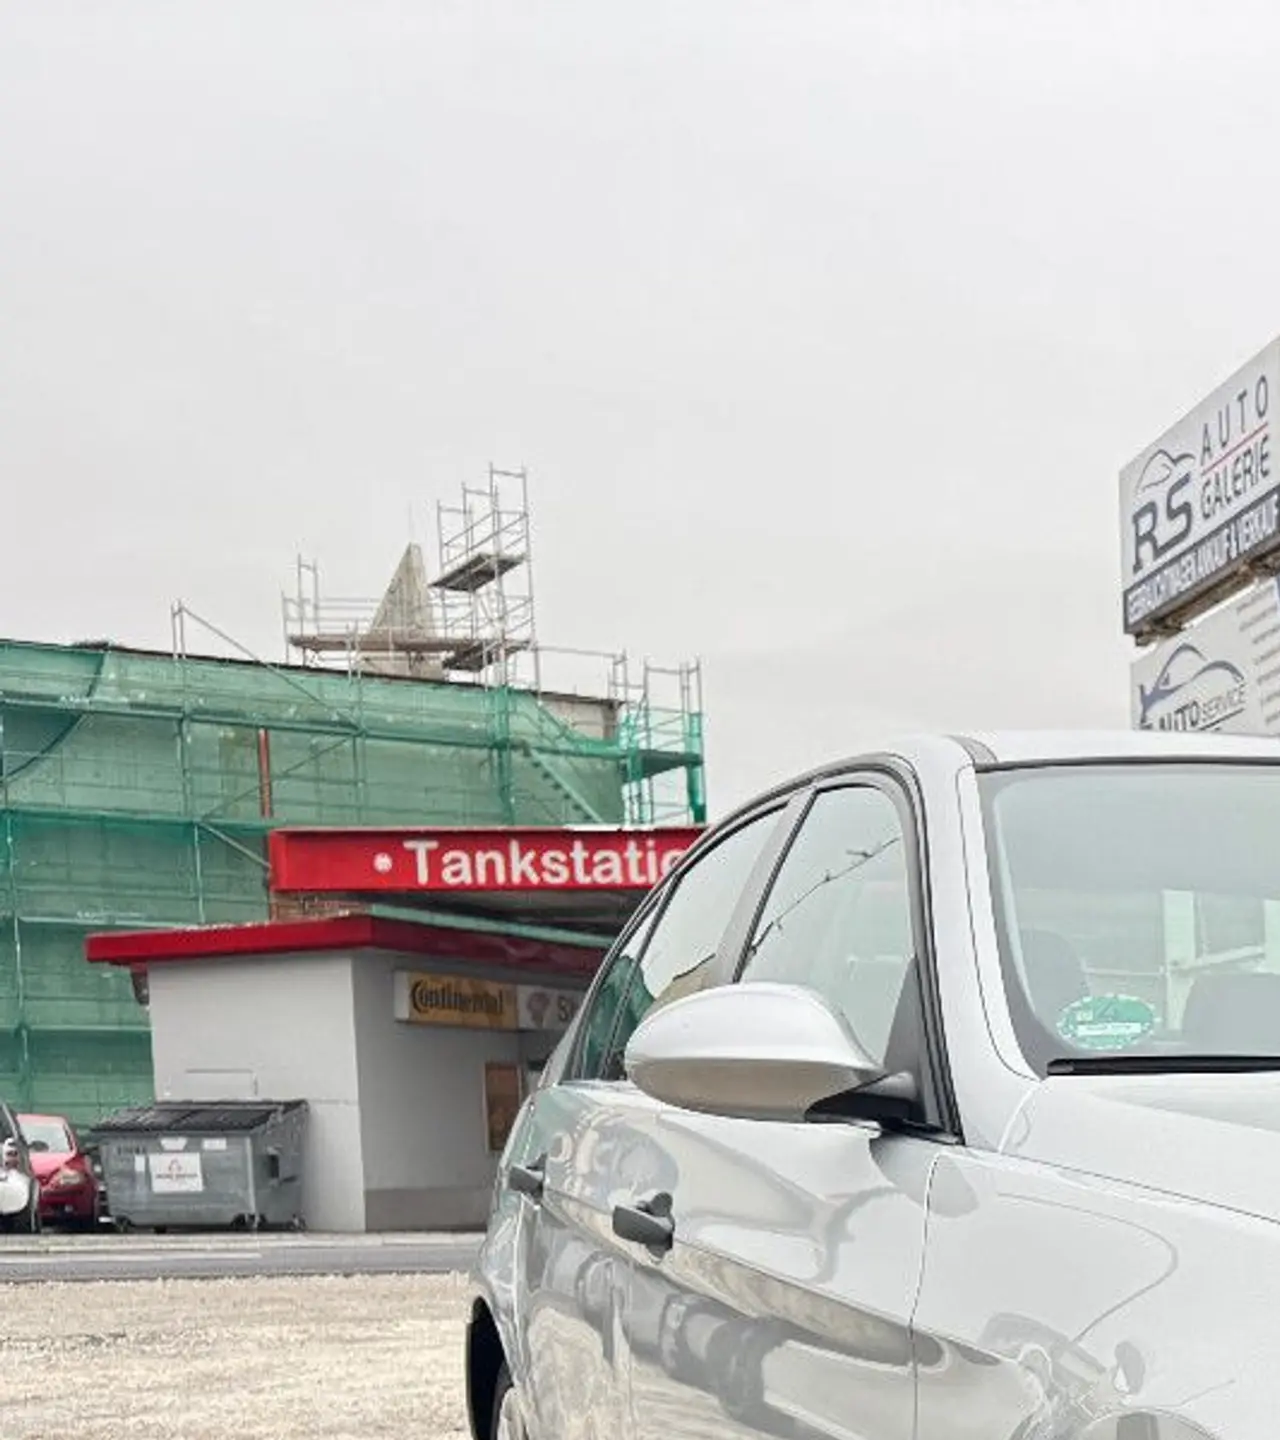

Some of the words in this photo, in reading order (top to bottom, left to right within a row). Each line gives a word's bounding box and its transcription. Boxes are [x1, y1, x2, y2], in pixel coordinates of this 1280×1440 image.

[1200, 374, 1268, 467] AUTO
[1201, 433, 1270, 520] GALERIE
[1132, 471, 1192, 575] RS
[411, 979, 504, 1015] Continental
